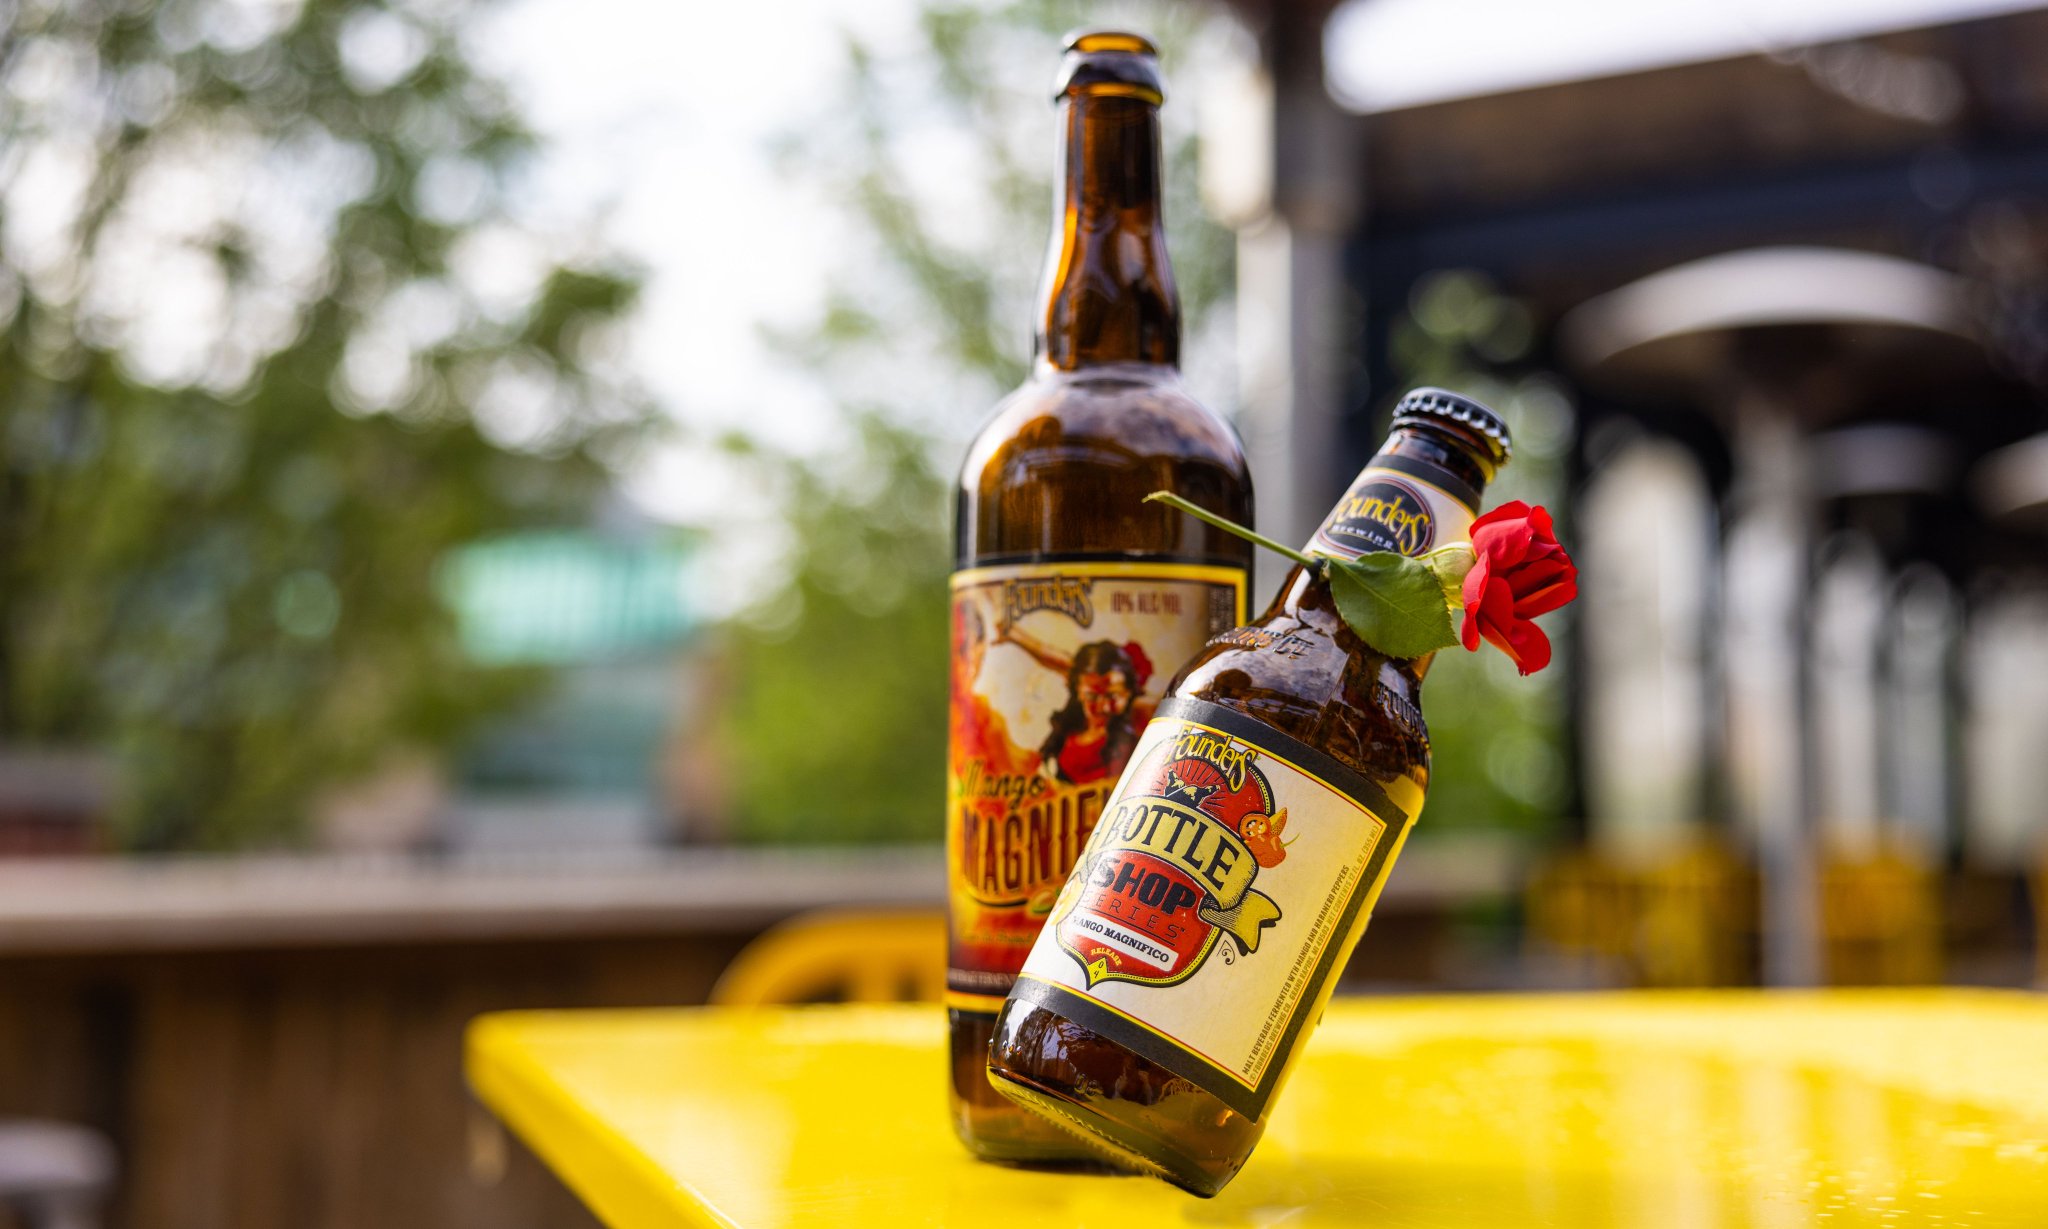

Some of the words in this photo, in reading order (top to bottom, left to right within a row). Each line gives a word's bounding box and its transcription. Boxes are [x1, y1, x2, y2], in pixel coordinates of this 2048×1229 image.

[1003, 574, 1094, 630] Founders
[1162, 724, 1258, 795] Founders
[1100, 804, 1240, 892] BOTTLE
[1093, 857, 1197, 915] SHOP
[1090, 947, 1123, 967] RELEASE
[1103, 927, 1170, 963] MAGNIFICO
[1242, 1053, 1256, 1075] MALT
[1252, 1020, 1272, 1056] BEVERAGE
[1269, 981, 1292, 1022] FERMENTED
[1296, 941, 1311, 967] MANGO
[1308, 927, 1318, 943] AND
[1315, 893, 1335, 929] HABANERO
[1332, 864, 1350, 895] PEPPERS
[1253, 1039, 1273, 1074] FOUNDERS
[1269, 1010, 1287, 1042] BREWING
[1290, 978, 1303, 1000] GRAND
[1316, 924, 1330, 947] 49503
[1327, 909, 1337, 925] NET
[1333, 879, 1352, 913] CONTENTS
